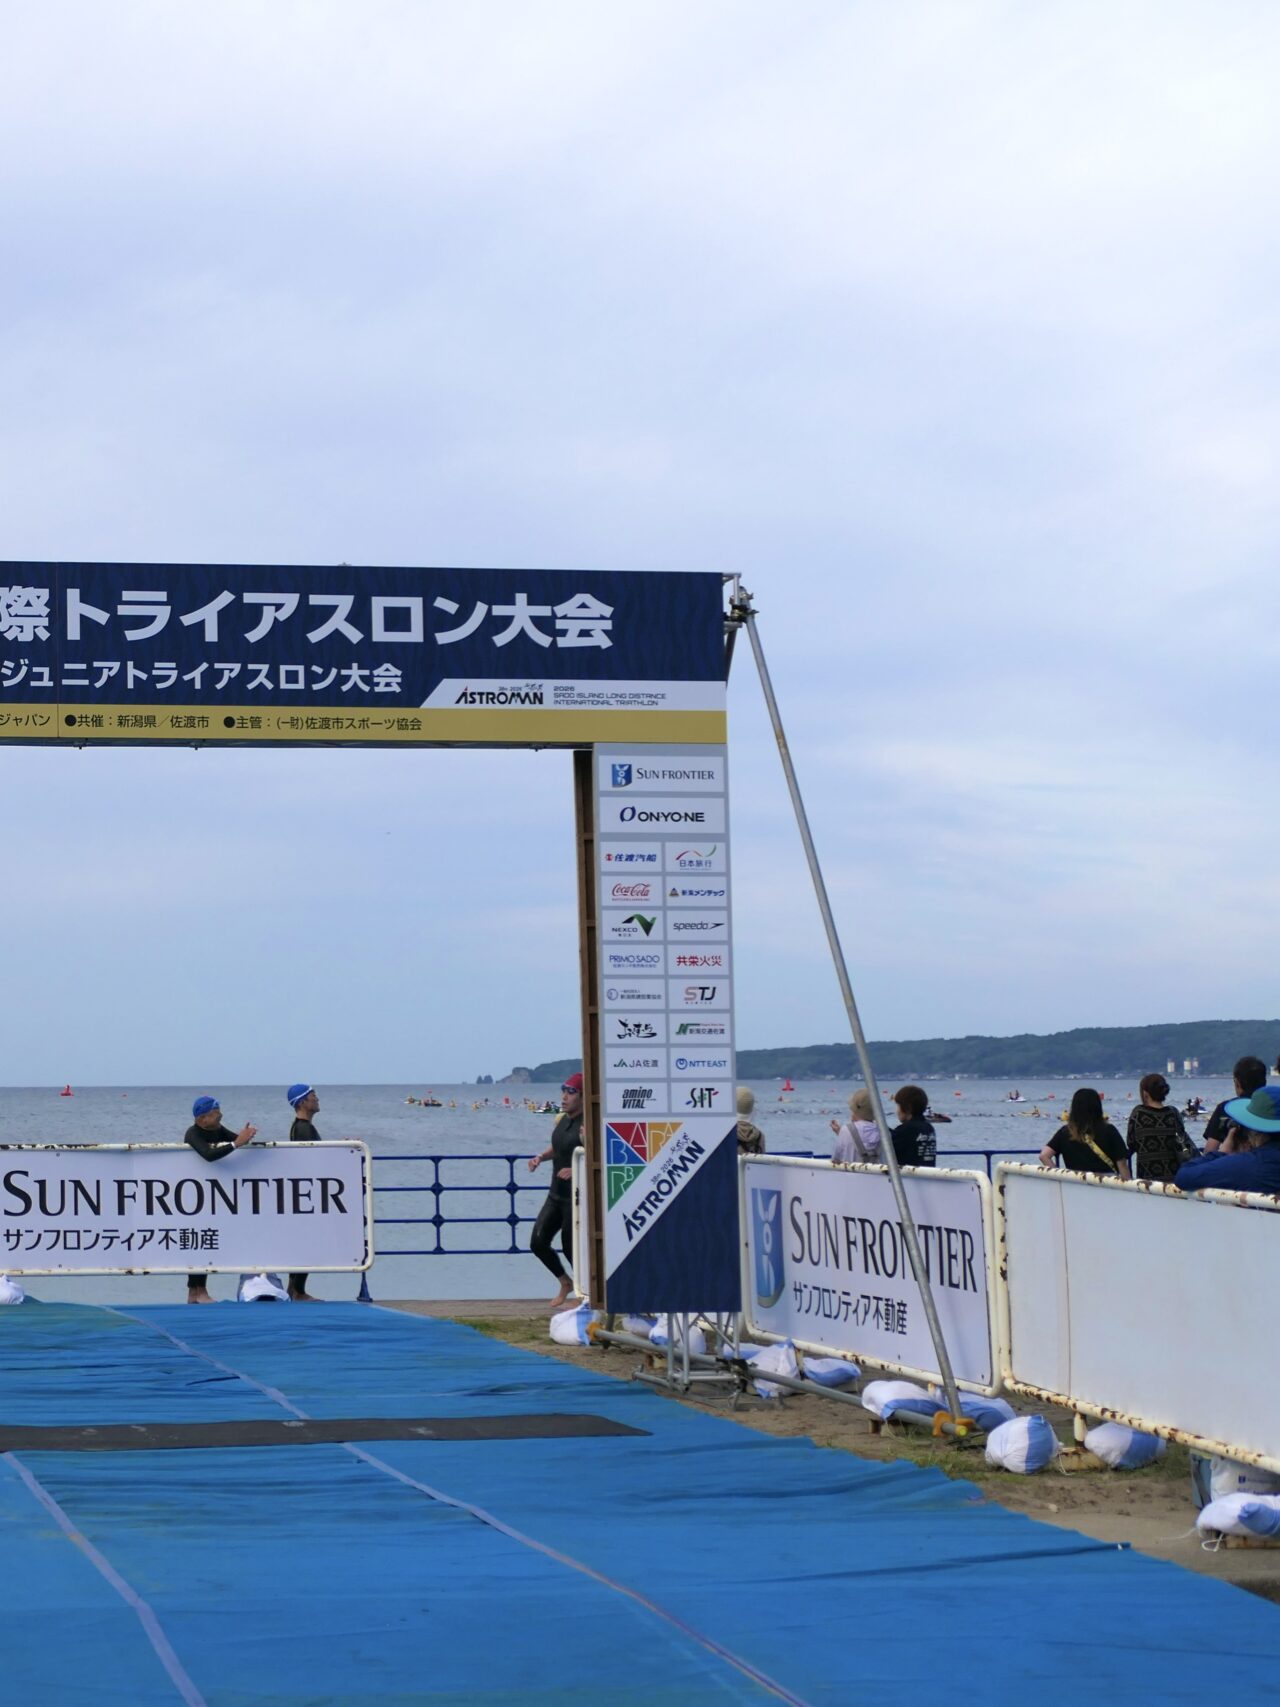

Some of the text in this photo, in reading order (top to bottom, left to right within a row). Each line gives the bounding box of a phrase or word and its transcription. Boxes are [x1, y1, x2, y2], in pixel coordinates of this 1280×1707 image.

[454, 686, 543, 705] ASTROMAN
[637, 768, 715, 780] SUN FRONTIER
[673, 921, 709, 932] speedo
[609, 955, 660, 963] PRIMO SADO
[676, 955, 722, 967] 共栄火災
[684, 986, 717, 1001] STJ
[622, 1086, 653, 1099] amino
[622, 1099, 646, 1109] VITAL
[2, 1169, 348, 1217] SUN FRONTIER
[622, 1140, 705, 1242] ASTROMAN
[2, 1227, 220, 1251] サンフロンティア不動産
[789, 1195, 840, 1271] SUN
[793, 1281, 908, 1336] サンフロンティア不動産
